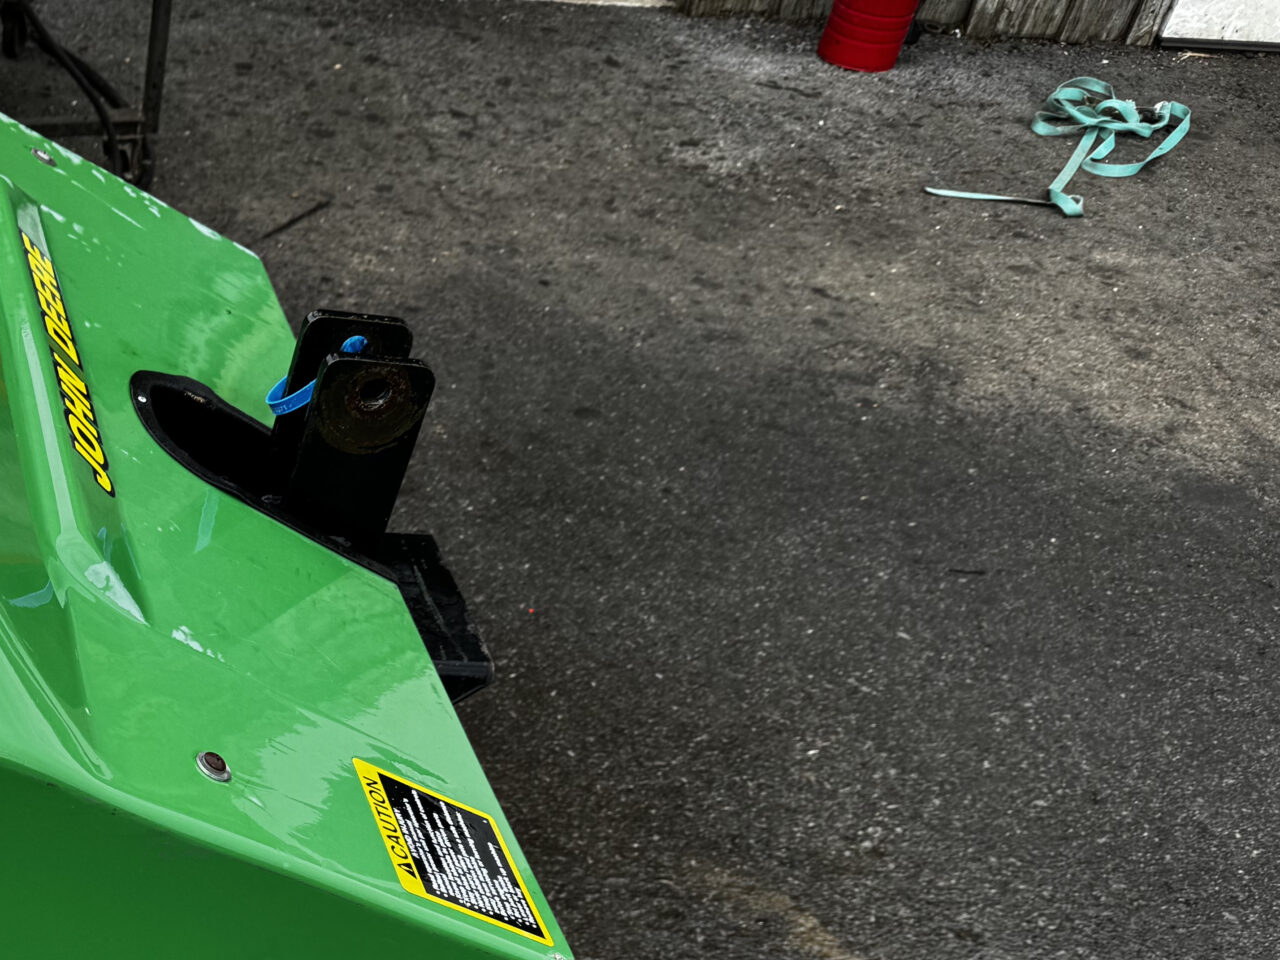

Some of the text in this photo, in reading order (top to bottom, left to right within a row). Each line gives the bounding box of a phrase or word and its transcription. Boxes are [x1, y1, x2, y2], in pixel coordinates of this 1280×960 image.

[21, 231, 112, 492] JOHN DEERE
[363, 776, 408, 866] CAUTION
